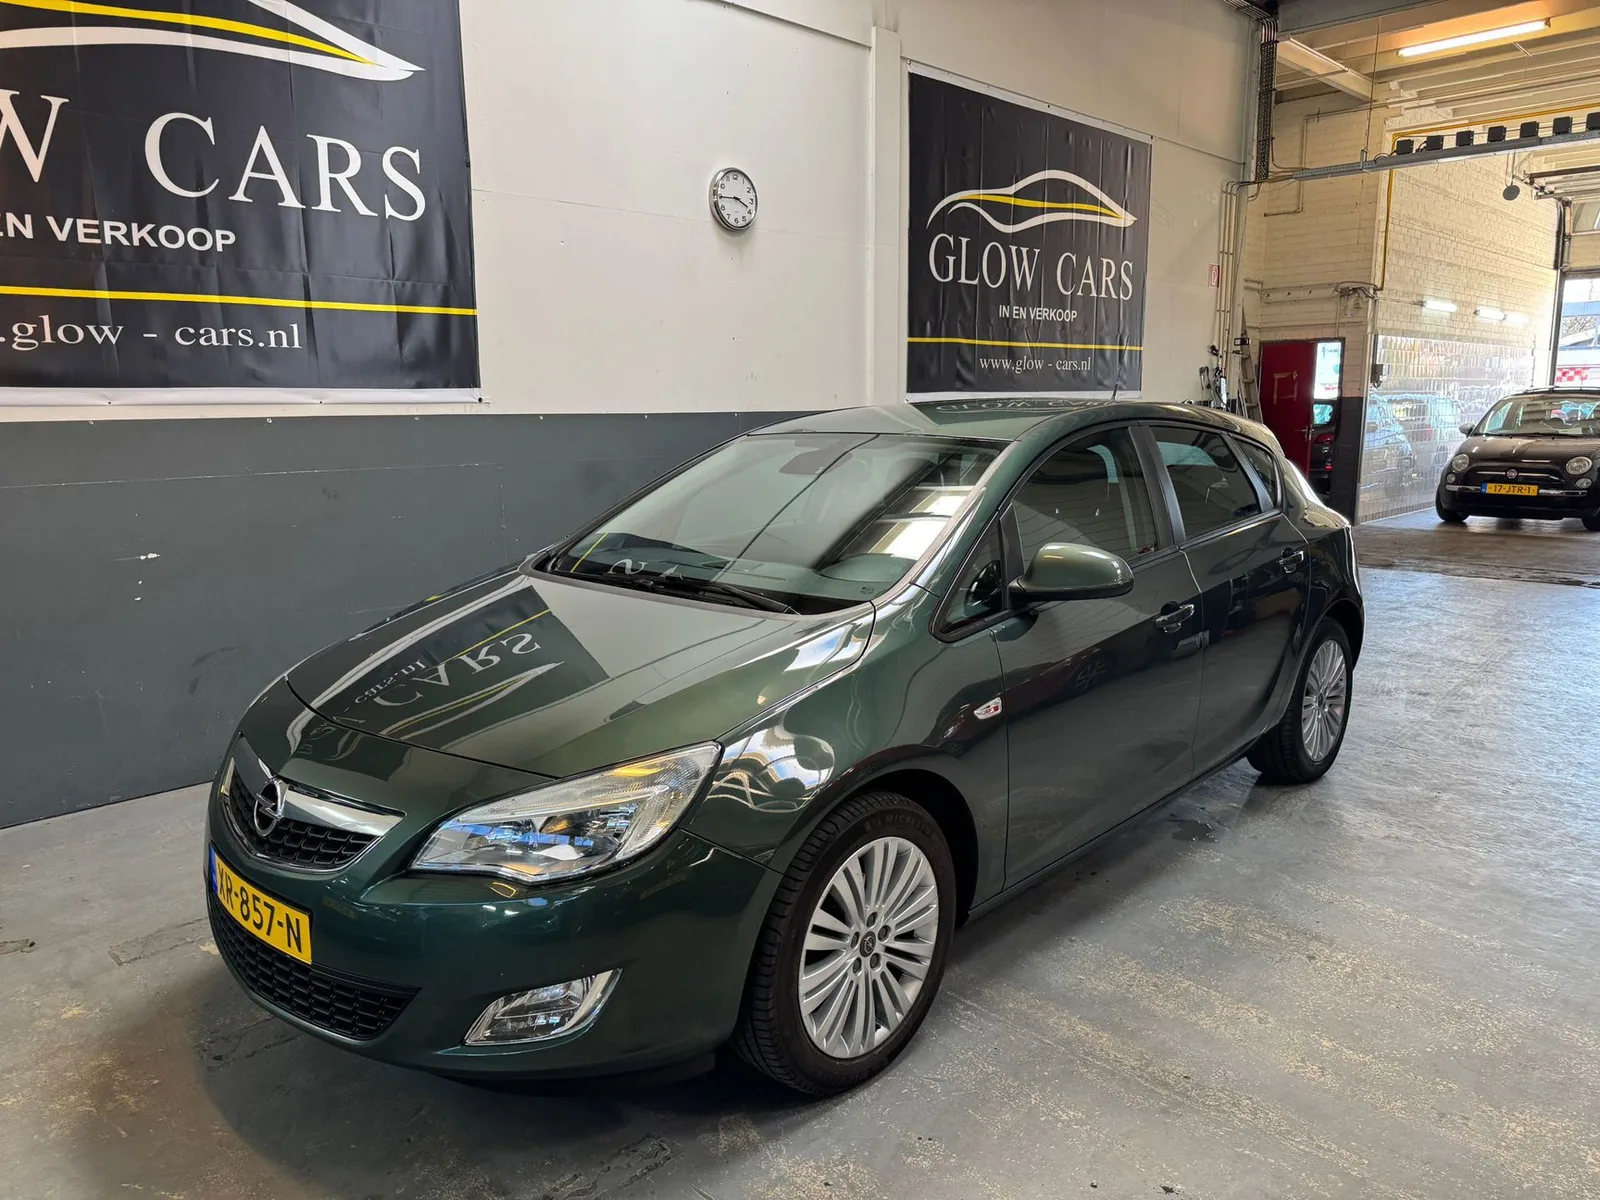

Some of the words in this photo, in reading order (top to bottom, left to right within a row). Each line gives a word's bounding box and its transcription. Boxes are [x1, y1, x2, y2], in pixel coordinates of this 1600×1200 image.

[144, 112, 427, 221] CARS
[0, 213, 33, 239] N
[46, 217, 237, 252] VERKOOP
[928, 233, 1041, 292] GLOW
[1056, 252, 1133, 300] CARS
[998, 304, 1010, 318] IN
[1012, 306, 1027, 319] EN
[1029, 307, 1078, 322] VERKOOP
[174, 323, 303, 349] cars.nl
[979, 355, 1044, 373] www.glow
[1055, 357, 1091, 371] cars.nl
[1494, 484, 1531, 494] 17-JTR-1
[217, 862, 303, 952] XR-857-N
